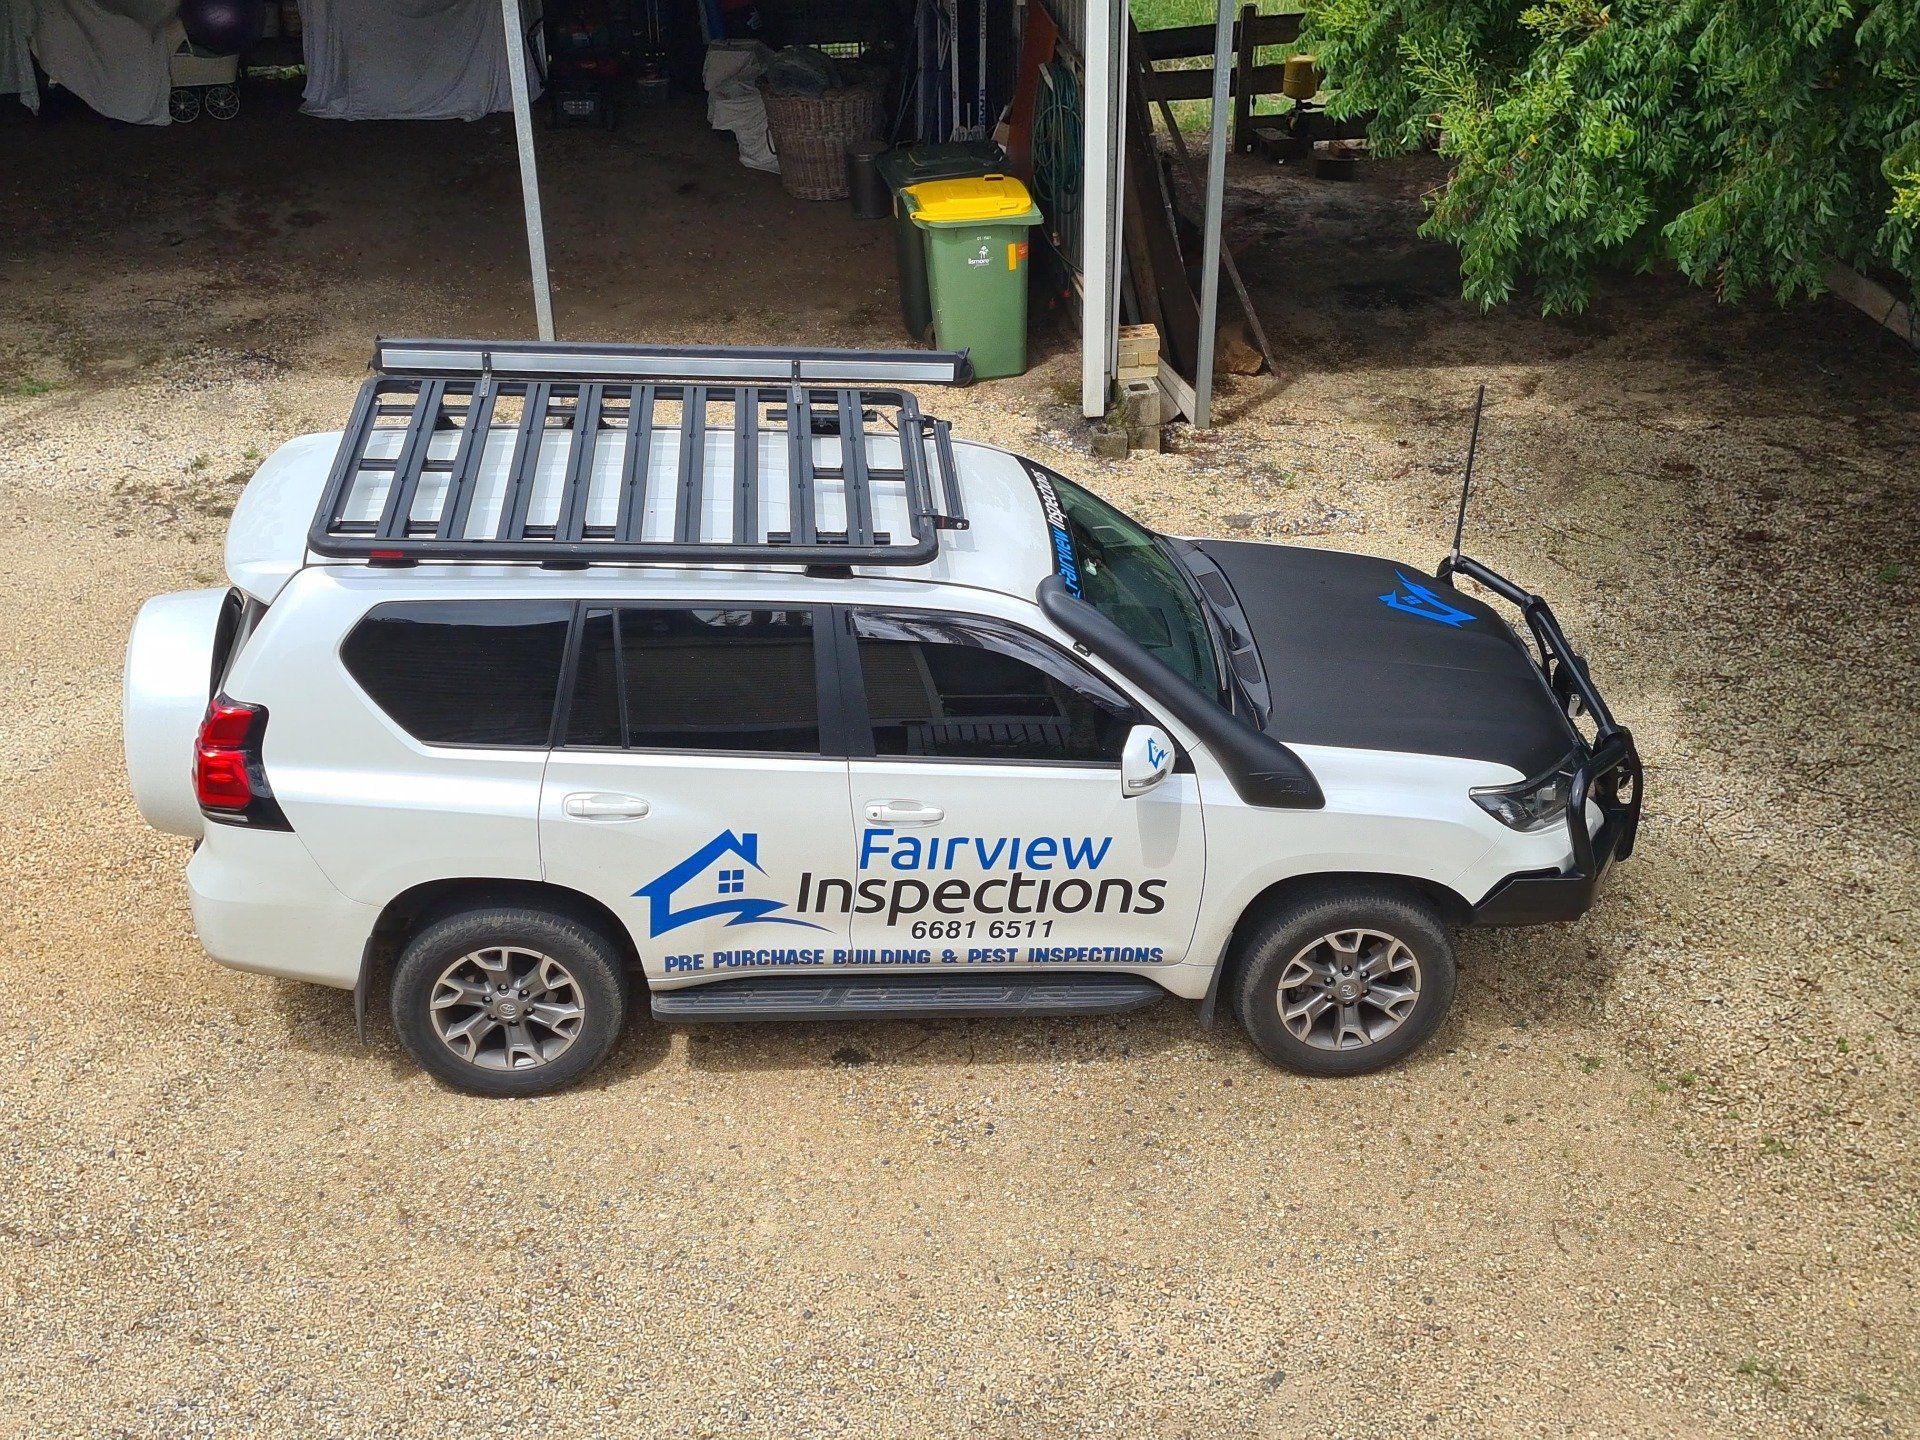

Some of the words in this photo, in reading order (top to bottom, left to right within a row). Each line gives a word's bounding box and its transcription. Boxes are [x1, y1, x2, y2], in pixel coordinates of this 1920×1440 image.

[1031, 469, 1067, 531] Inspections
[860, 828, 1112, 871] Fairview
[797, 871, 1168, 927] Inspections
[911, 920, 975, 940] 6681
[988, 920, 1054, 939] 6511
[664, 954, 704, 973] PRE
[713, 949, 826, 969] PURCHASE
[833, 948, 931, 965] BUILDING
[941, 949, 959, 963] &
[967, 948, 1019, 964] PEST
[1028, 947, 1164, 963] INSPECTIONS
